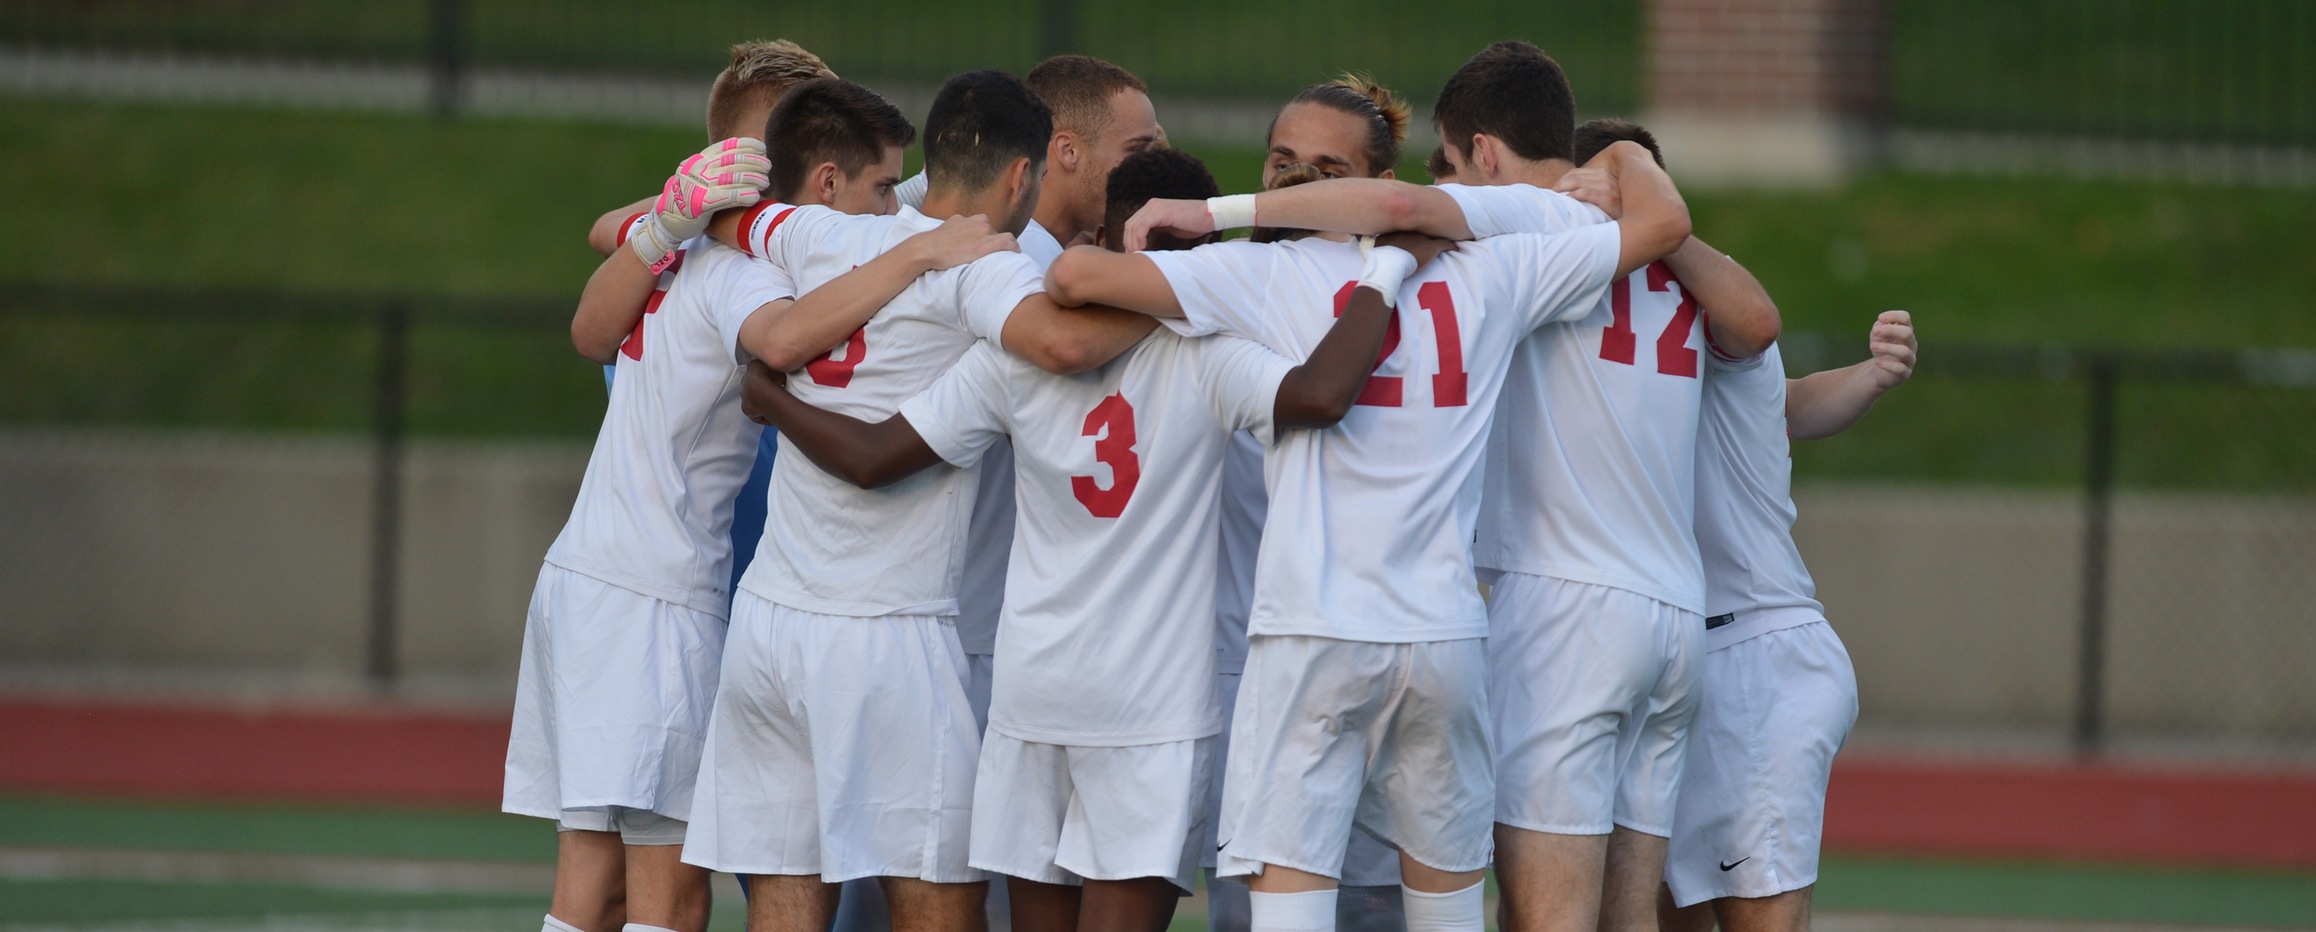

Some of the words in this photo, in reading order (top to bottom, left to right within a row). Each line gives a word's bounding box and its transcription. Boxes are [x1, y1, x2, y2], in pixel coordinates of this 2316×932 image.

[1333, 280, 1468, 408] 21
[1599, 260, 1698, 379] 12
[1071, 389, 1140, 518] 3
